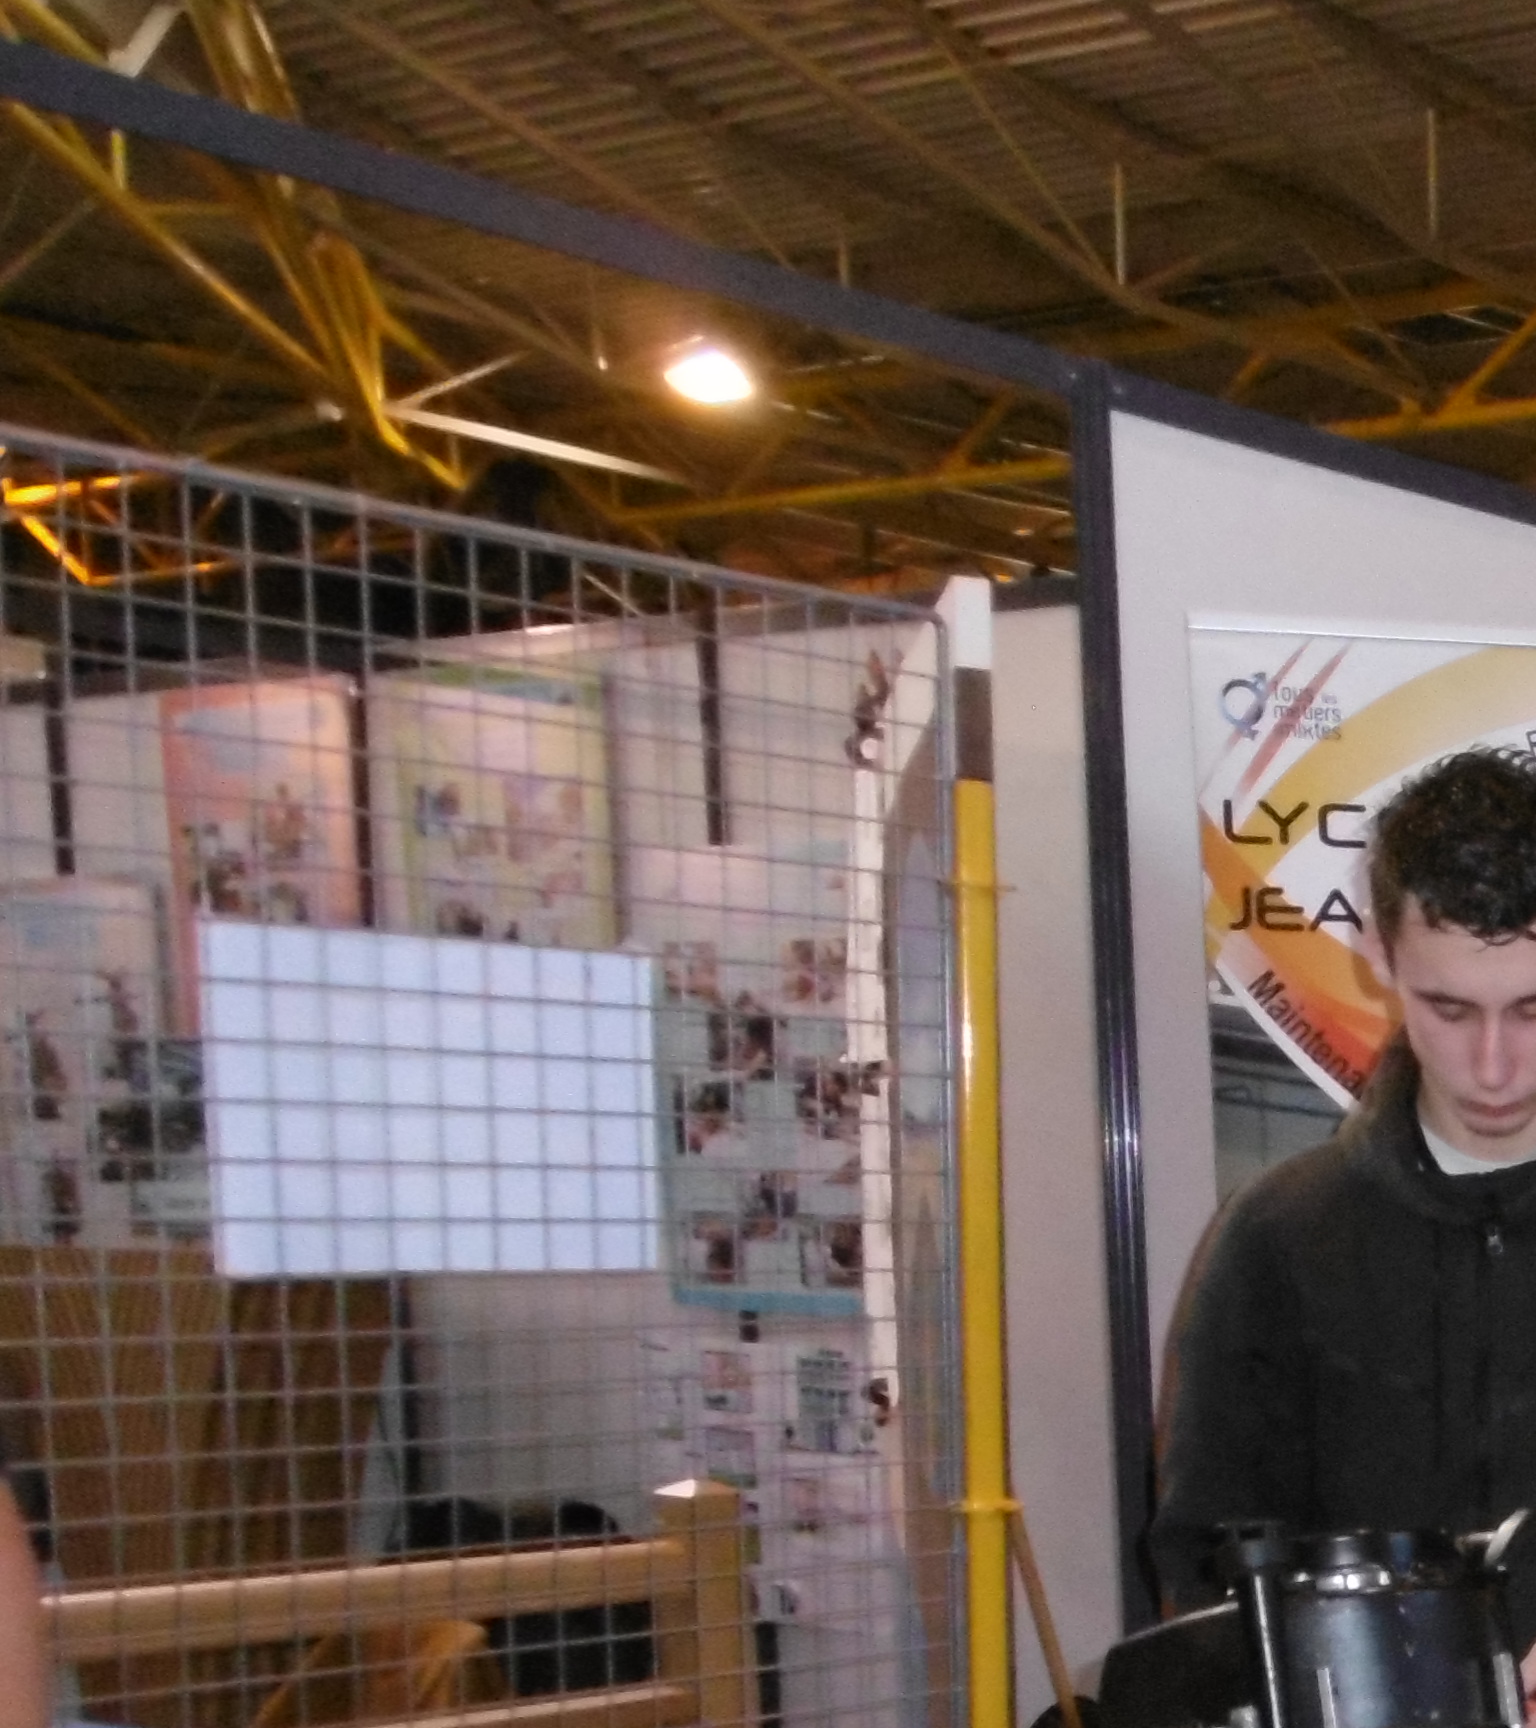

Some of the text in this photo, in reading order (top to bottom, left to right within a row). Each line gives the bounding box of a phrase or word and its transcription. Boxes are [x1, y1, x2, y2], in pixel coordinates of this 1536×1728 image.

[1222, 798, 1368, 849] LYC
[1228, 887, 1365, 934] JEA
[1247, 968, 1366, 1100] Maintena
